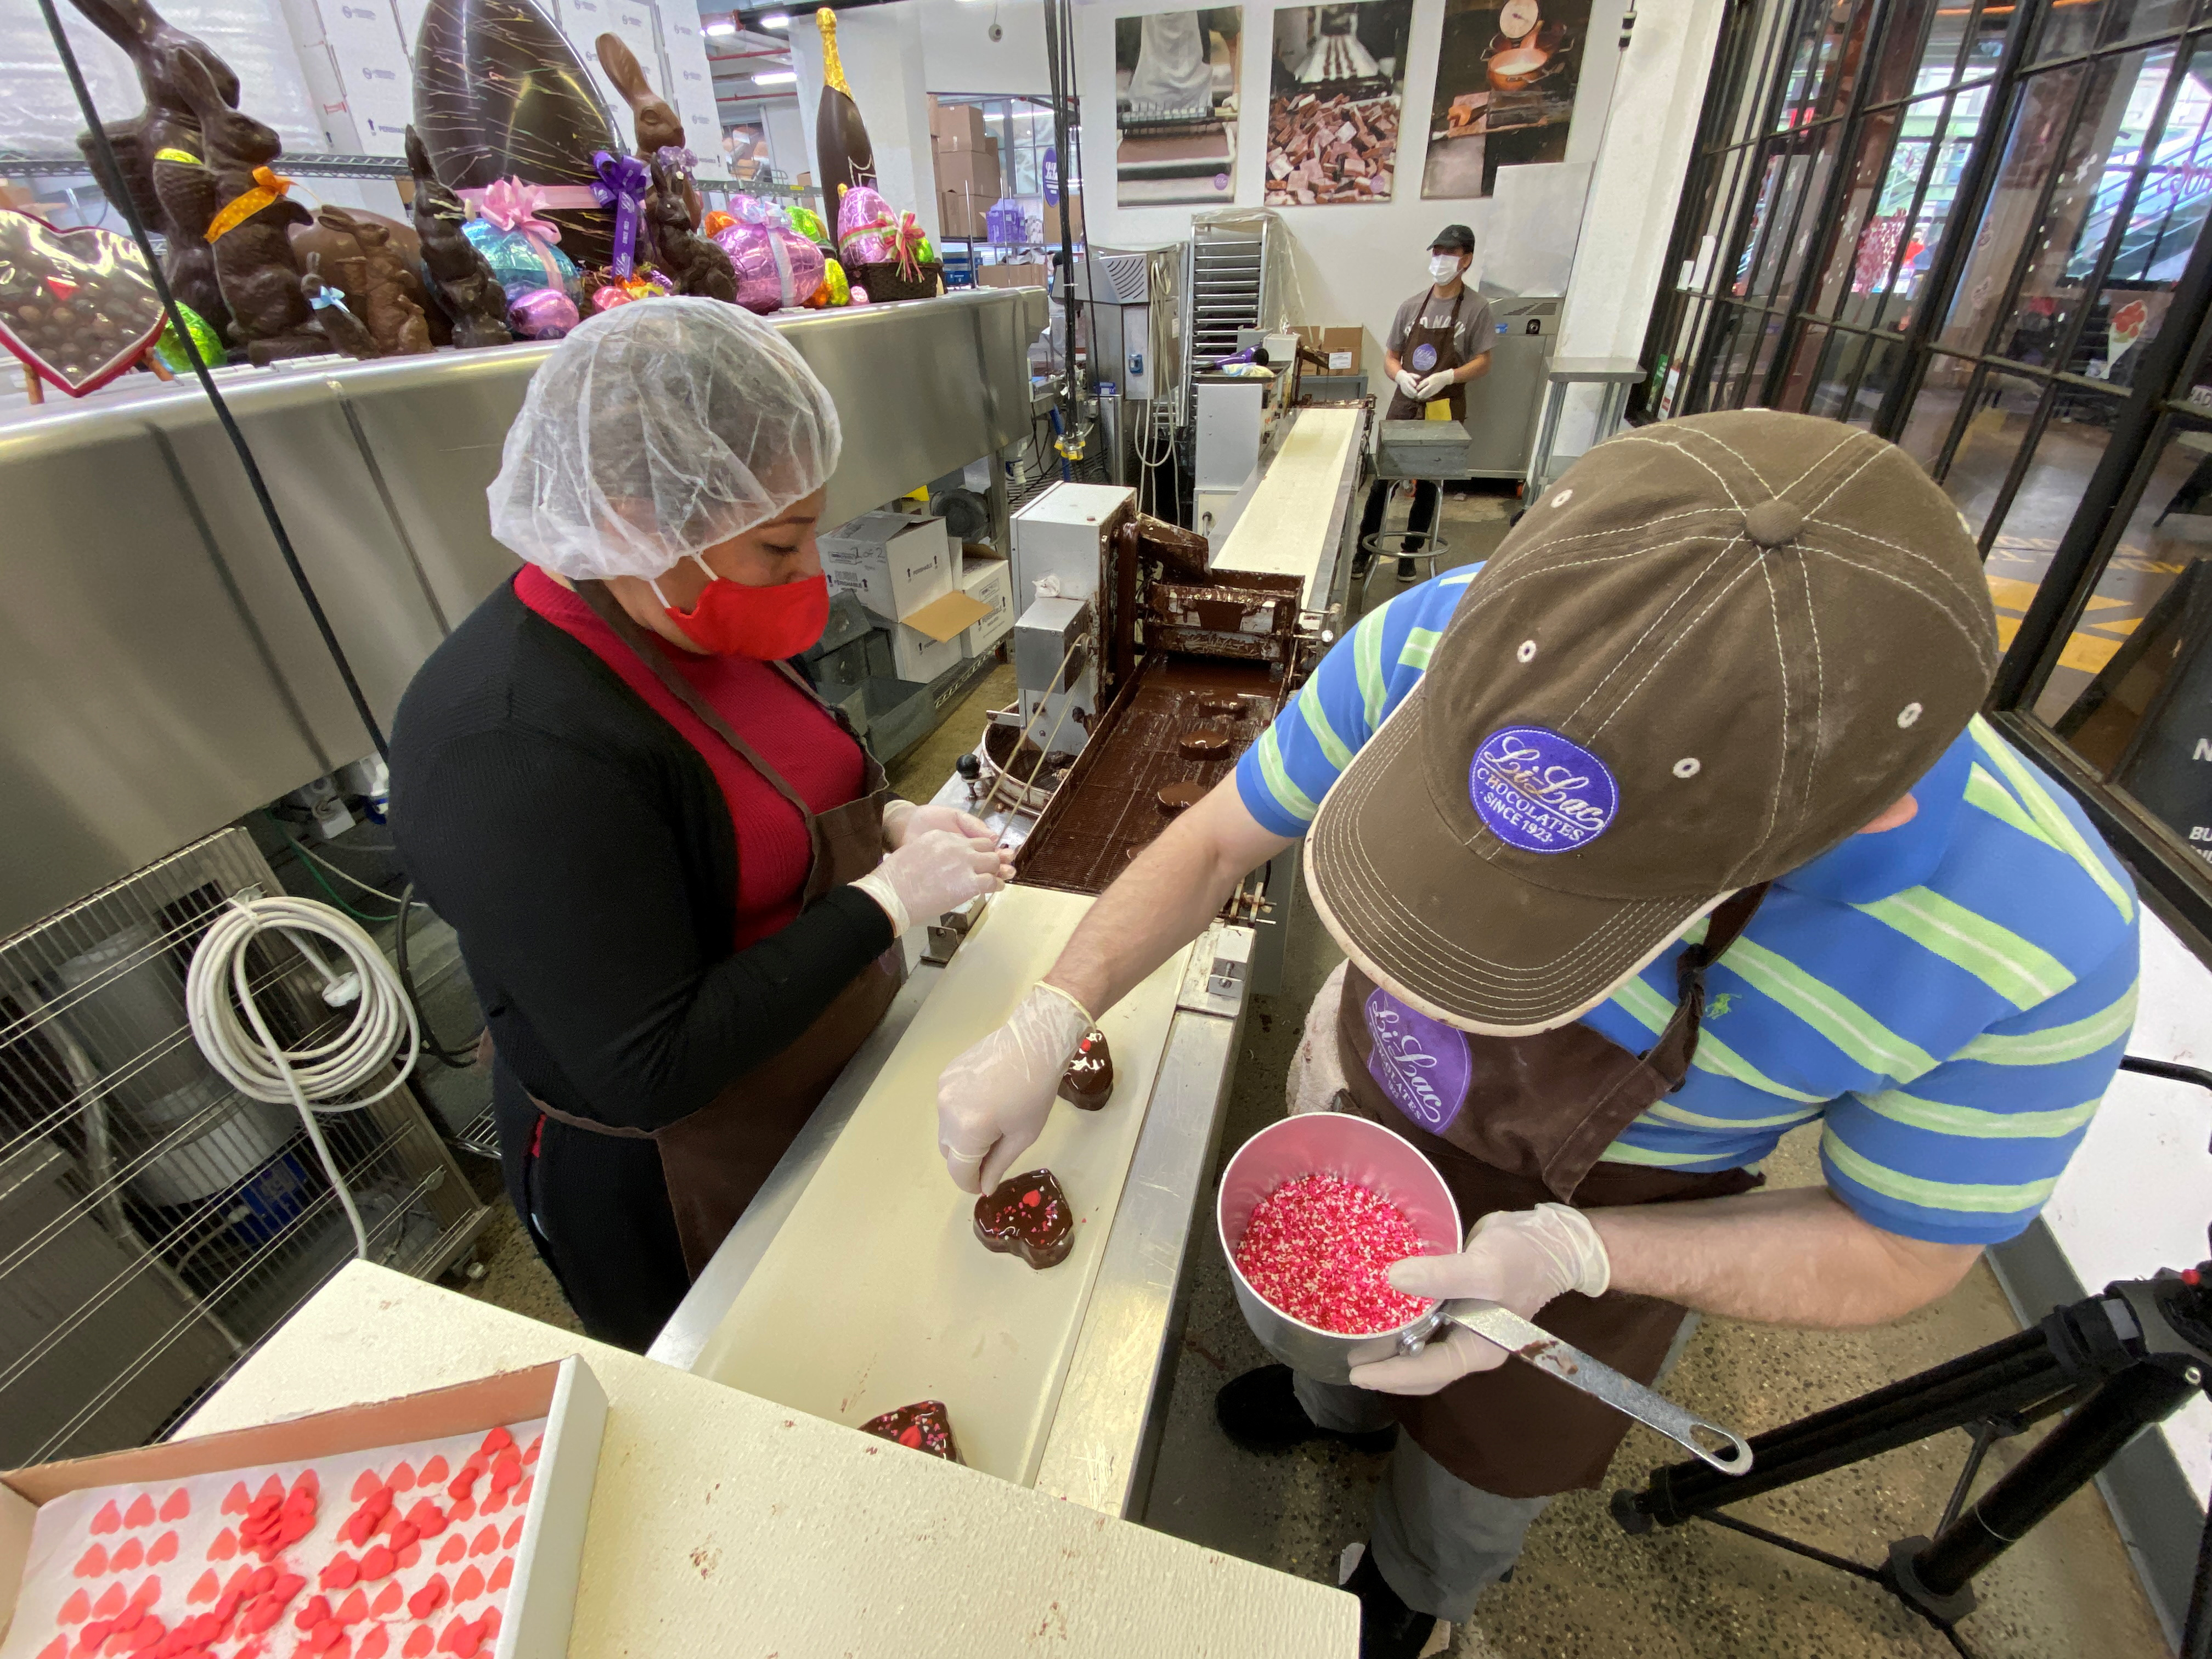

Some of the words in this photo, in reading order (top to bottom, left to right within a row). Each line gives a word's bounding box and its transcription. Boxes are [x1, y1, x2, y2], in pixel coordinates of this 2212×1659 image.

[876, 546, 886, 558] 2
[1476, 768, 1584, 841] CHOCOLATES
[1483, 736, 1605, 830] Li-Lac
[1483, 792, 1523, 826] SINCE
[1522, 820, 1552, 843] 1923
